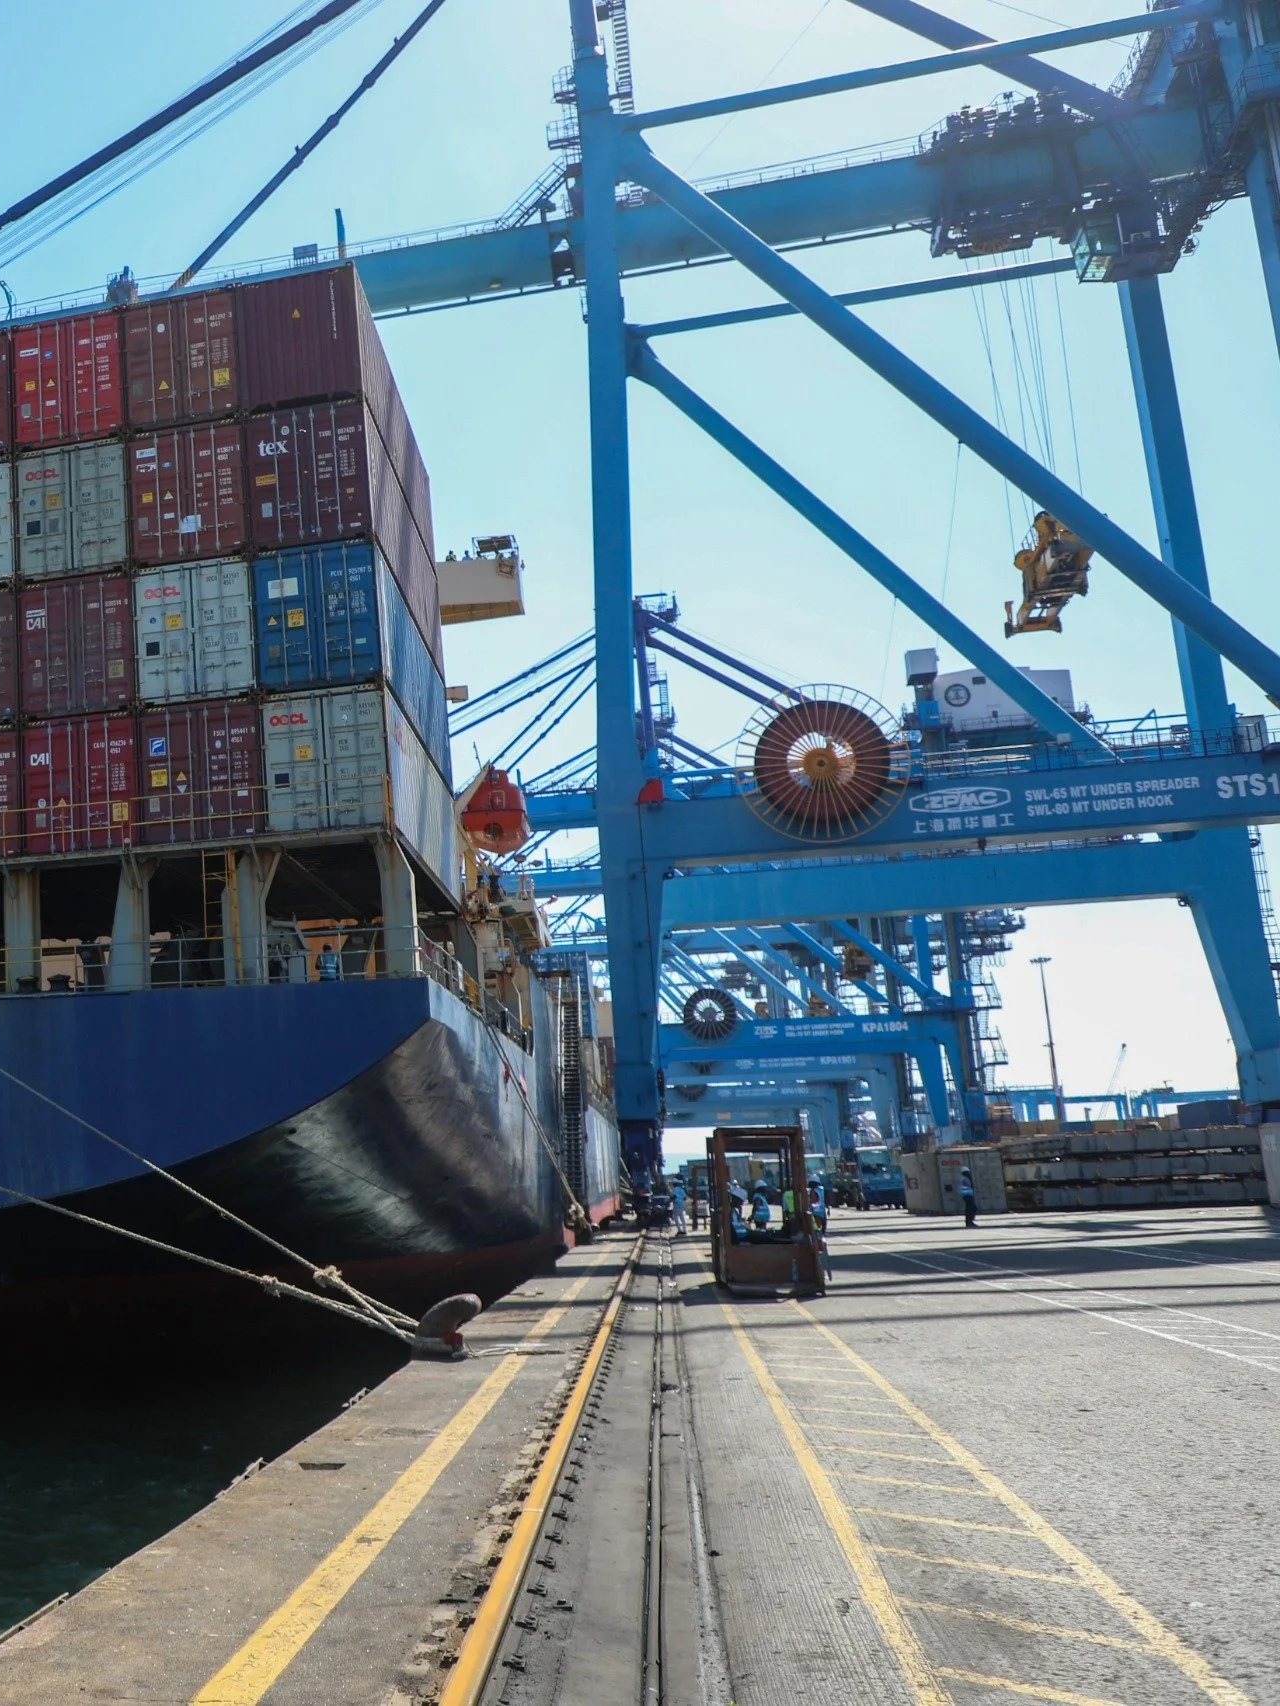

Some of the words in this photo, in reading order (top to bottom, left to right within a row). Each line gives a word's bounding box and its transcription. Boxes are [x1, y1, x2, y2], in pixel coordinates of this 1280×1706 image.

[258, 440, 288, 456] tex
[25, 468, 59, 481] OOCL
[144, 585, 180, 599] OOCL
[26, 617, 46, 630] CAI
[269, 712, 308, 726] OOCL
[30, 752, 50, 765] CAI
[1024, 787, 1067, 801] SWL-65
[1070, 785, 1087, 798] MT
[1091, 781, 1132, 796] UNDER
[1134, 776, 1200, 792] SPREADER
[924, 791, 998, 809] ZPMC
[1026, 802, 1070, 816] SWL-80
[1072, 800, 1089, 813] MT
[1093, 798, 1135, 811] UNDER
[1137, 794, 1173, 808] HOOK
